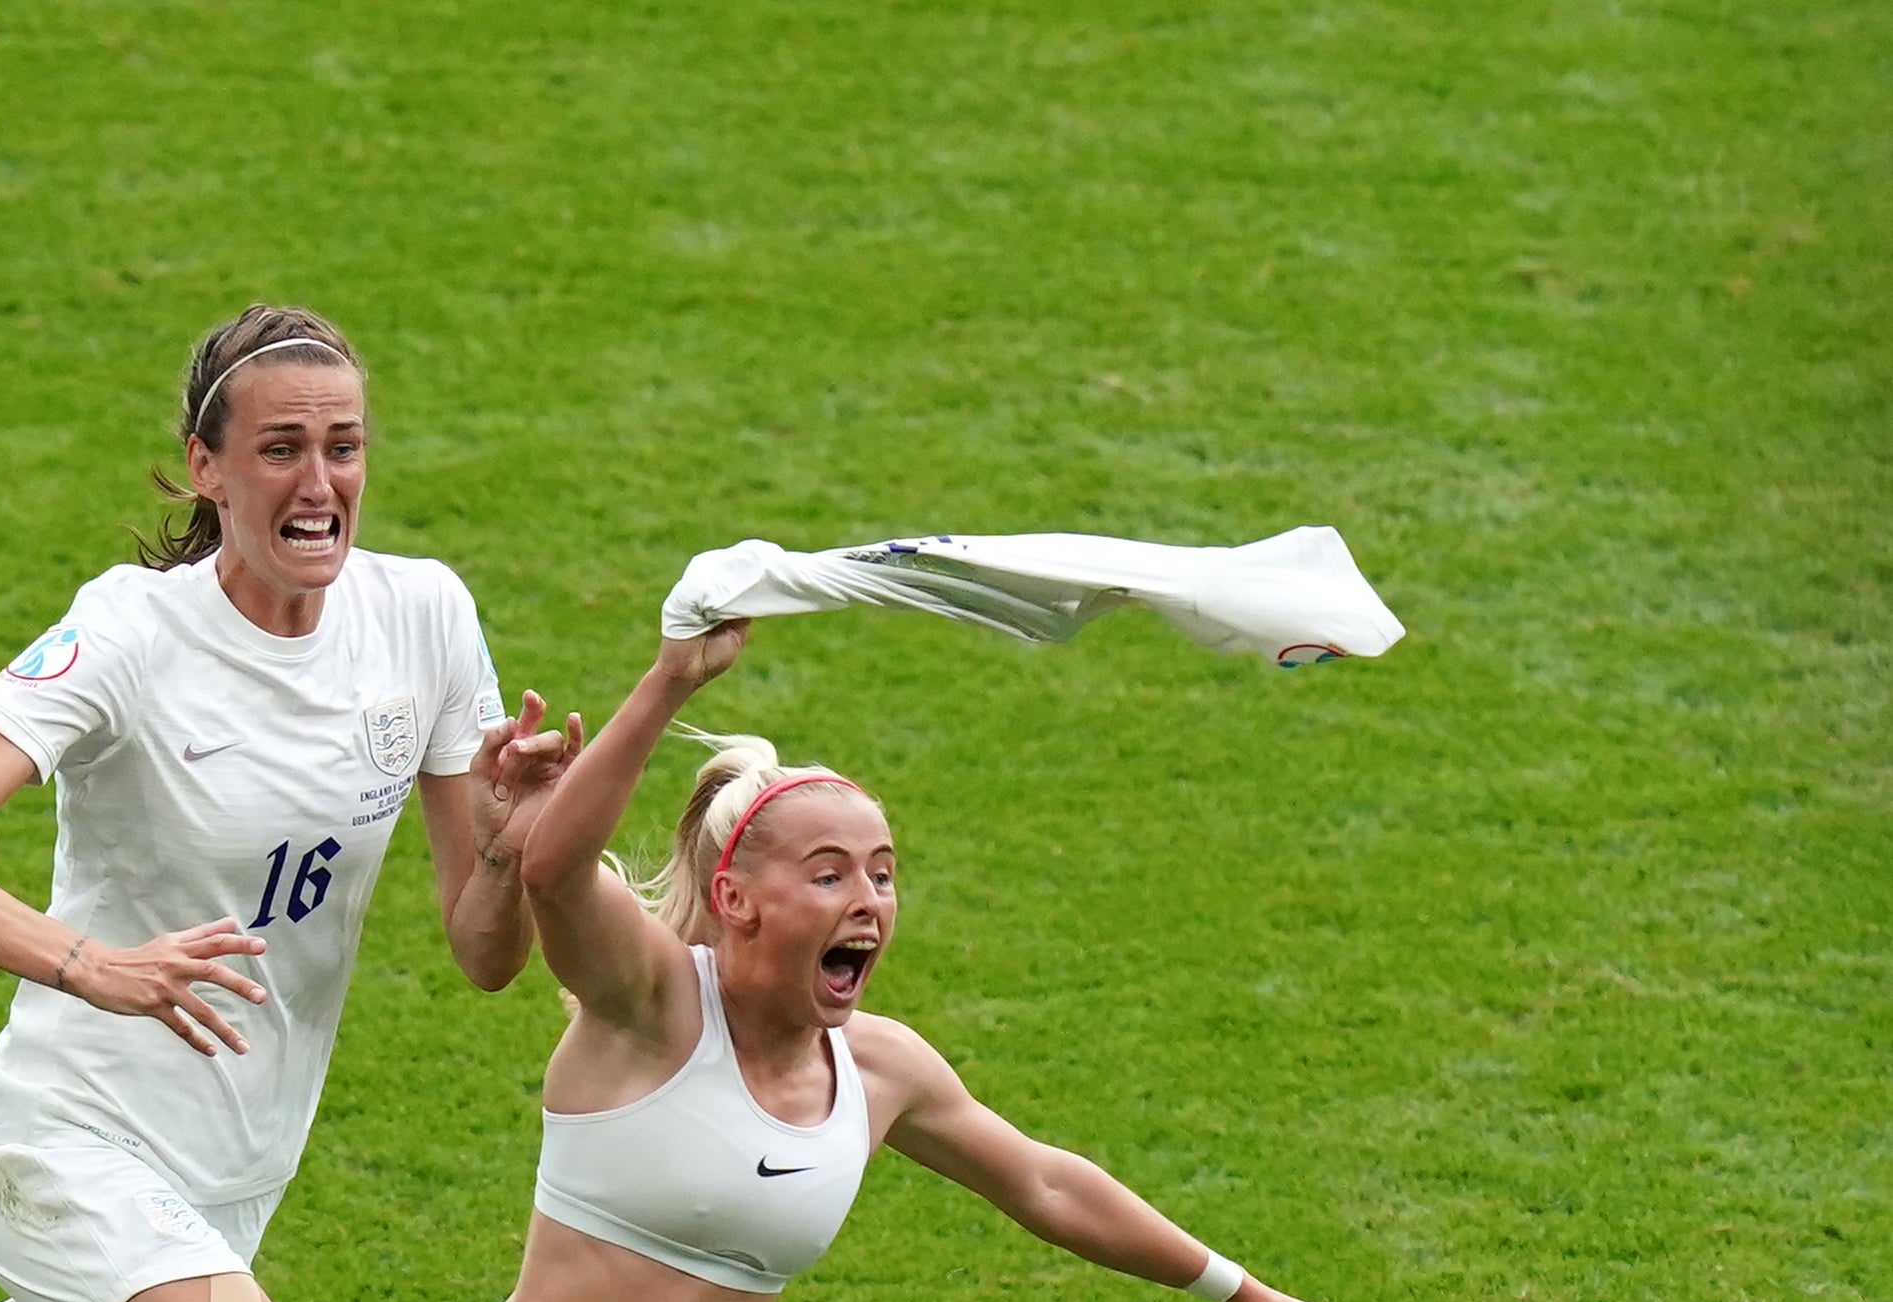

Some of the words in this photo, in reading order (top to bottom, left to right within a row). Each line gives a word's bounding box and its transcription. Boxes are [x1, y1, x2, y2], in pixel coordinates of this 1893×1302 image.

[360, 785, 392, 802] ENGLAND
[352, 814, 371, 826] UEFA
[247, 836, 342, 929] 16
